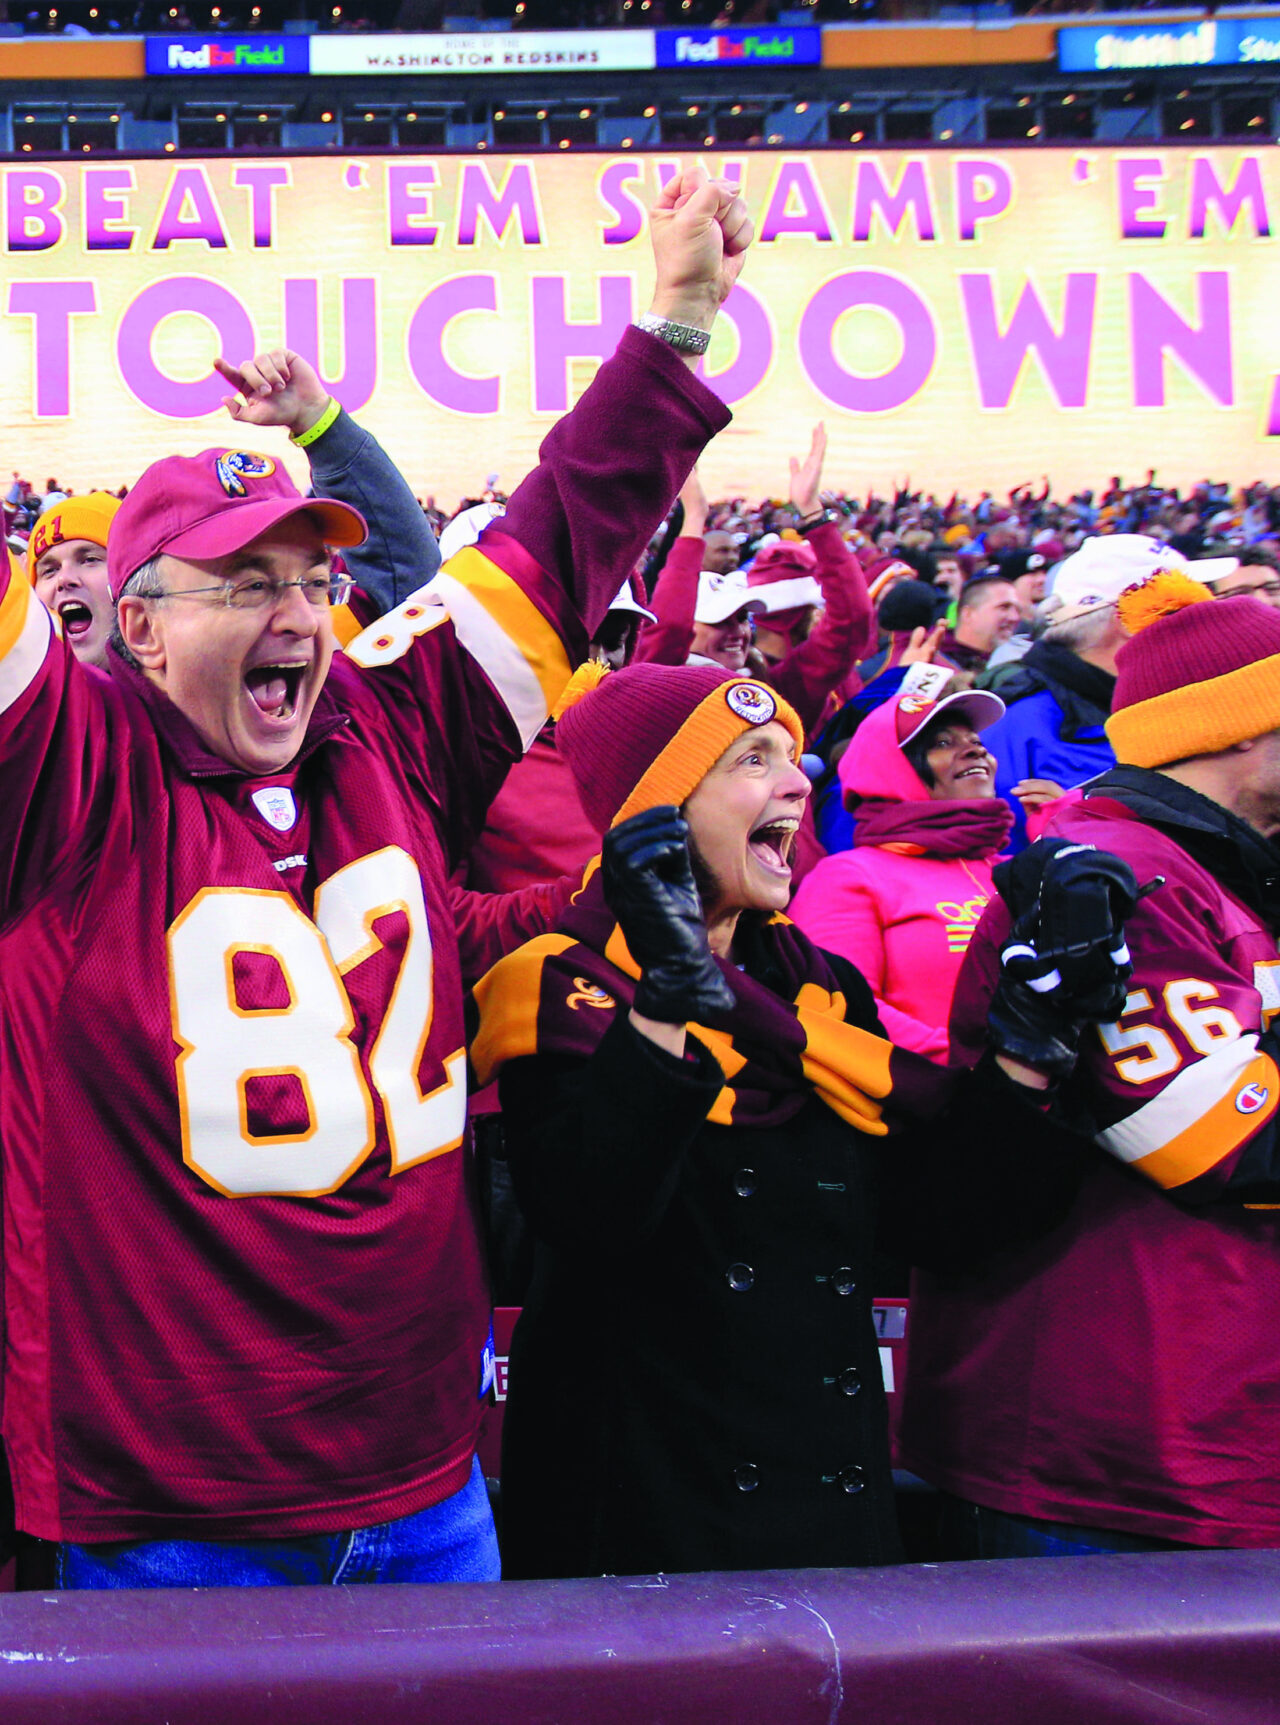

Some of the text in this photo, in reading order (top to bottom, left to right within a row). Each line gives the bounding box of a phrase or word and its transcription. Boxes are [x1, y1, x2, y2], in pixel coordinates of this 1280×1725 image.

[168, 44, 284, 68] FedExField
[367, 50, 599, 66] WASHINGTON REDSKINS
[4, 165, 293, 253] BEAT
[597, 156, 1015, 245] SAMP
[166, 843, 468, 1199] 82
[1096, 977, 1244, 1085] 56
